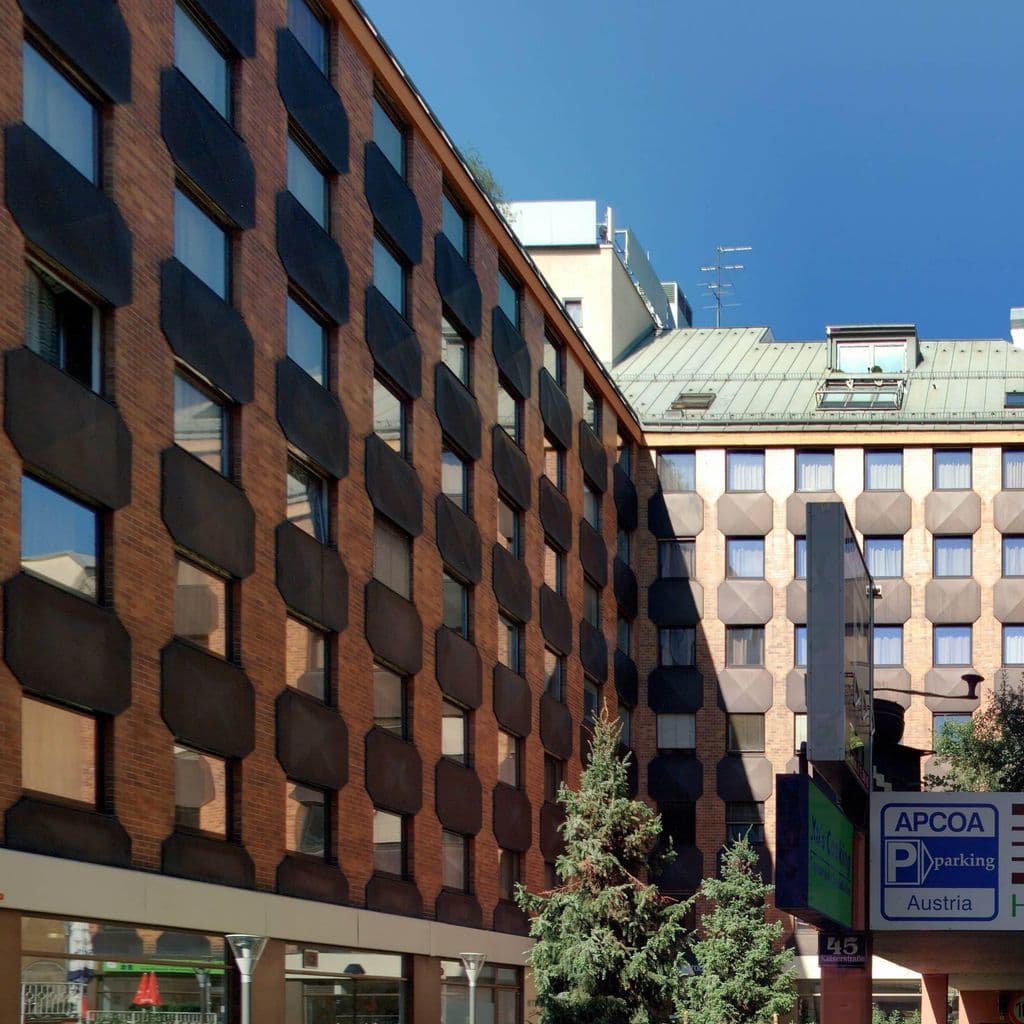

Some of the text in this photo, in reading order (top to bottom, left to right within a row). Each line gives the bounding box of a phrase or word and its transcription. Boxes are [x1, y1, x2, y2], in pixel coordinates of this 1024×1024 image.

[895, 812, 985, 832] APCOA
[933, 854, 995, 871] parking
[907, 895, 972, 911] Austria
[827, 936, 859, 955] 45
